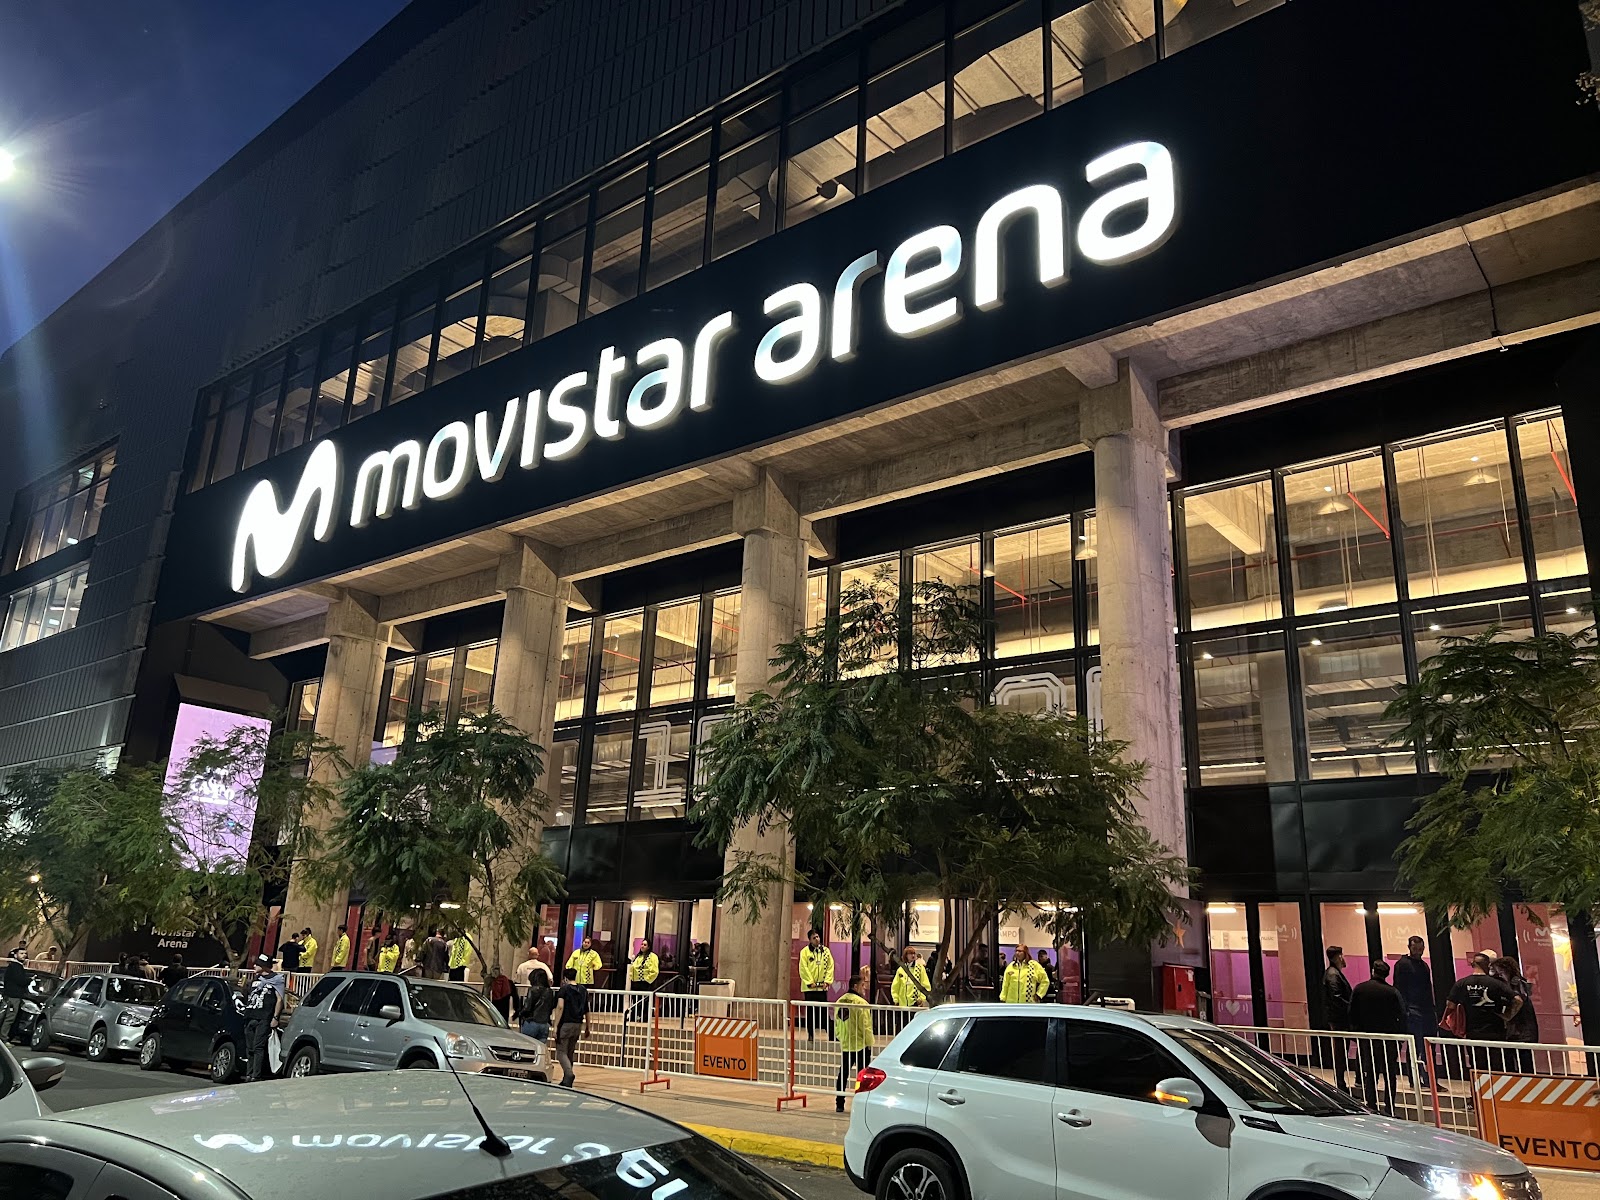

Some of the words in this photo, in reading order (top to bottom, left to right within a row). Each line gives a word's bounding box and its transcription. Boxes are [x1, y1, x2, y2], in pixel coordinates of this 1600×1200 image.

[350, 310, 733, 528] movistar
[754, 141, 1176, 382] arena
[157, 938, 188, 948] Arena
[703, 1055, 747, 1071] EVENTO
[1499, 1134, 1600, 1161] EVENTO
